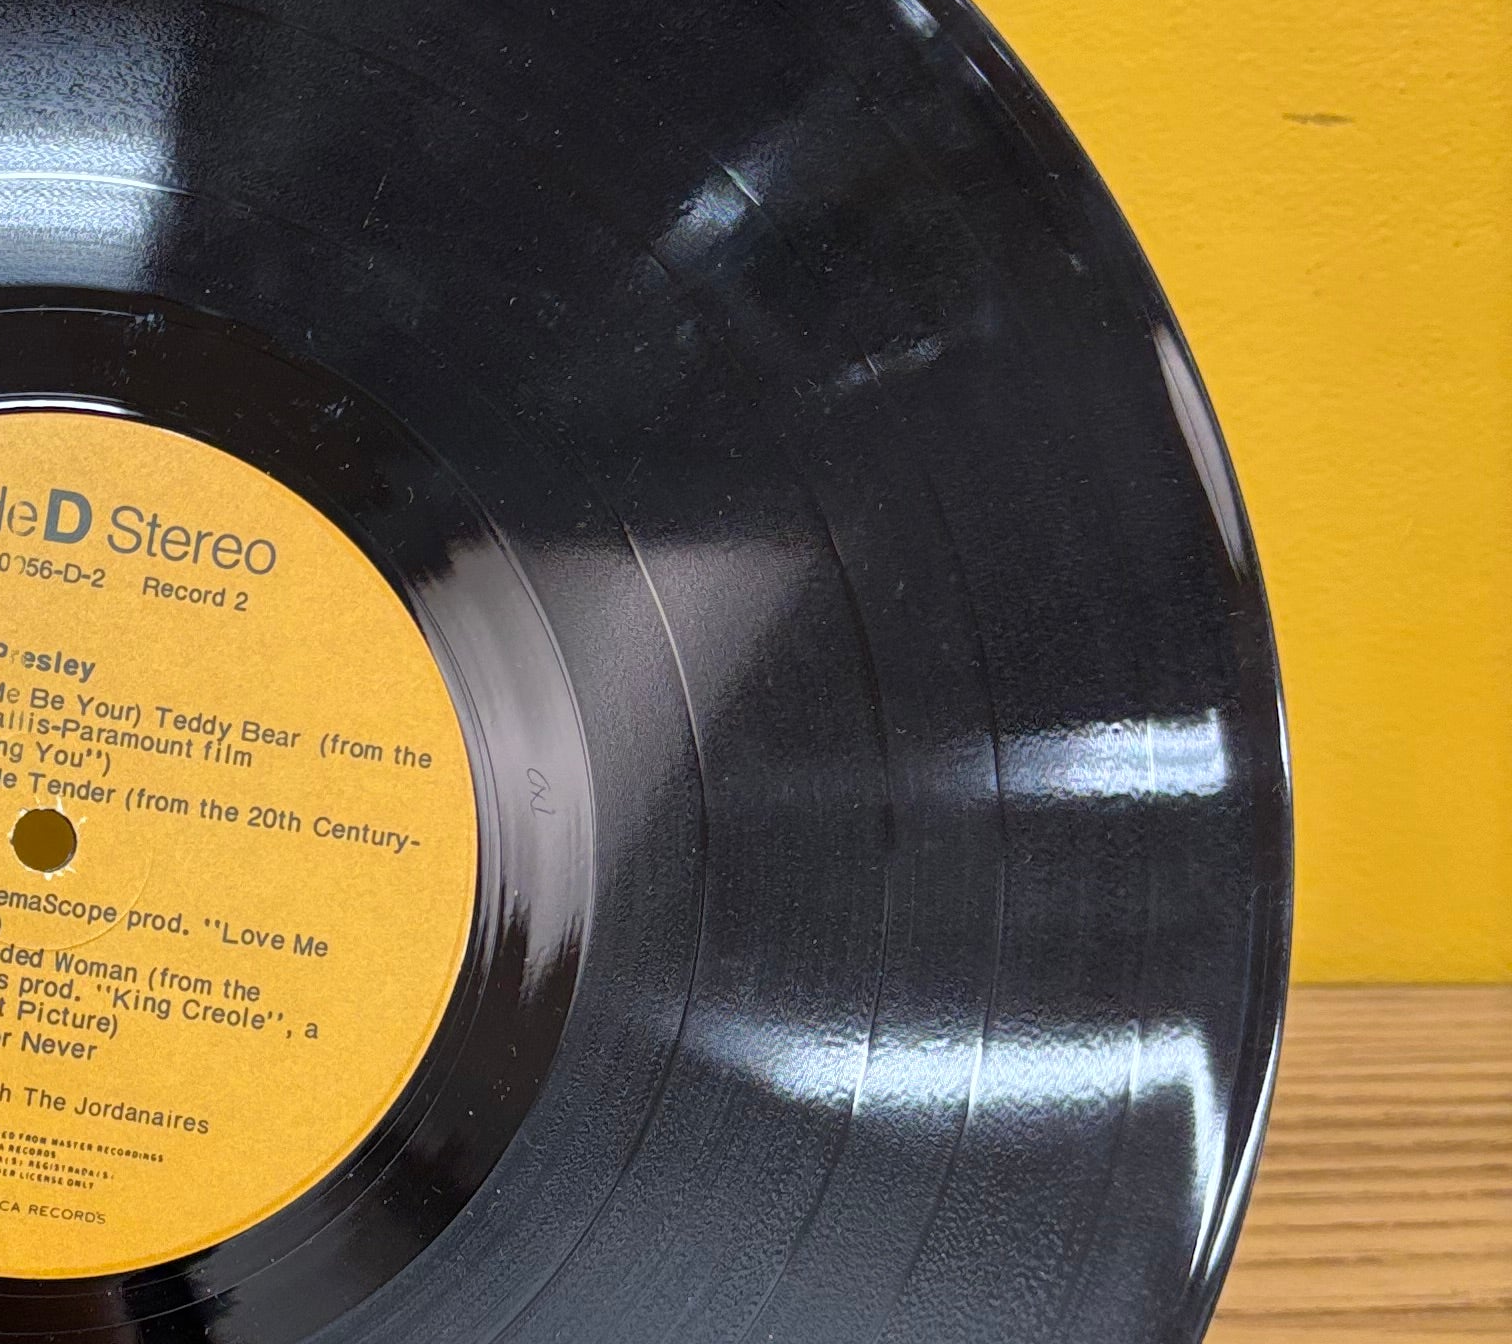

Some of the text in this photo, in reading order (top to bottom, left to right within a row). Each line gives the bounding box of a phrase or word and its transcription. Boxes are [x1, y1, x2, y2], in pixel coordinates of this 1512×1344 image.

[43, 488, 93, 545] D
[106, 505, 277, 576] Stereo
[141, 576, 227, 608] Record
[233, 591, 249, 612] 2
[29, 687, 65, 711] Be
[76, 693, 142, 728] Your)
[154, 705, 233, 741] Teddy
[240, 720, 302, 748] Bear
[319, 732, 384, 762] (from
[394, 745, 433, 769] the
[203, 738, 253, 768] film
[27, 771, 117, 804] Tender
[125, 787, 190, 816] (from
[199, 798, 240, 823] the
[246, 805, 302, 833] 20th
[312, 816, 421, 855] Century-
[126, 909, 190, 936] prod.
[292, 933, 329, 958] Me
[54, 949, 138, 984] Woman
[148, 966, 213, 996] (from
[223, 979, 261, 1003] the
[16, 999, 119, 1040] Picture)
[18, 976, 81, 1003] prod.
[304, 1022, 319, 1040] a
[20, 1030, 98, 1061] Never
[23, 1086, 67, 1112] The
[73, 1096, 209, 1135] Jordanaires
